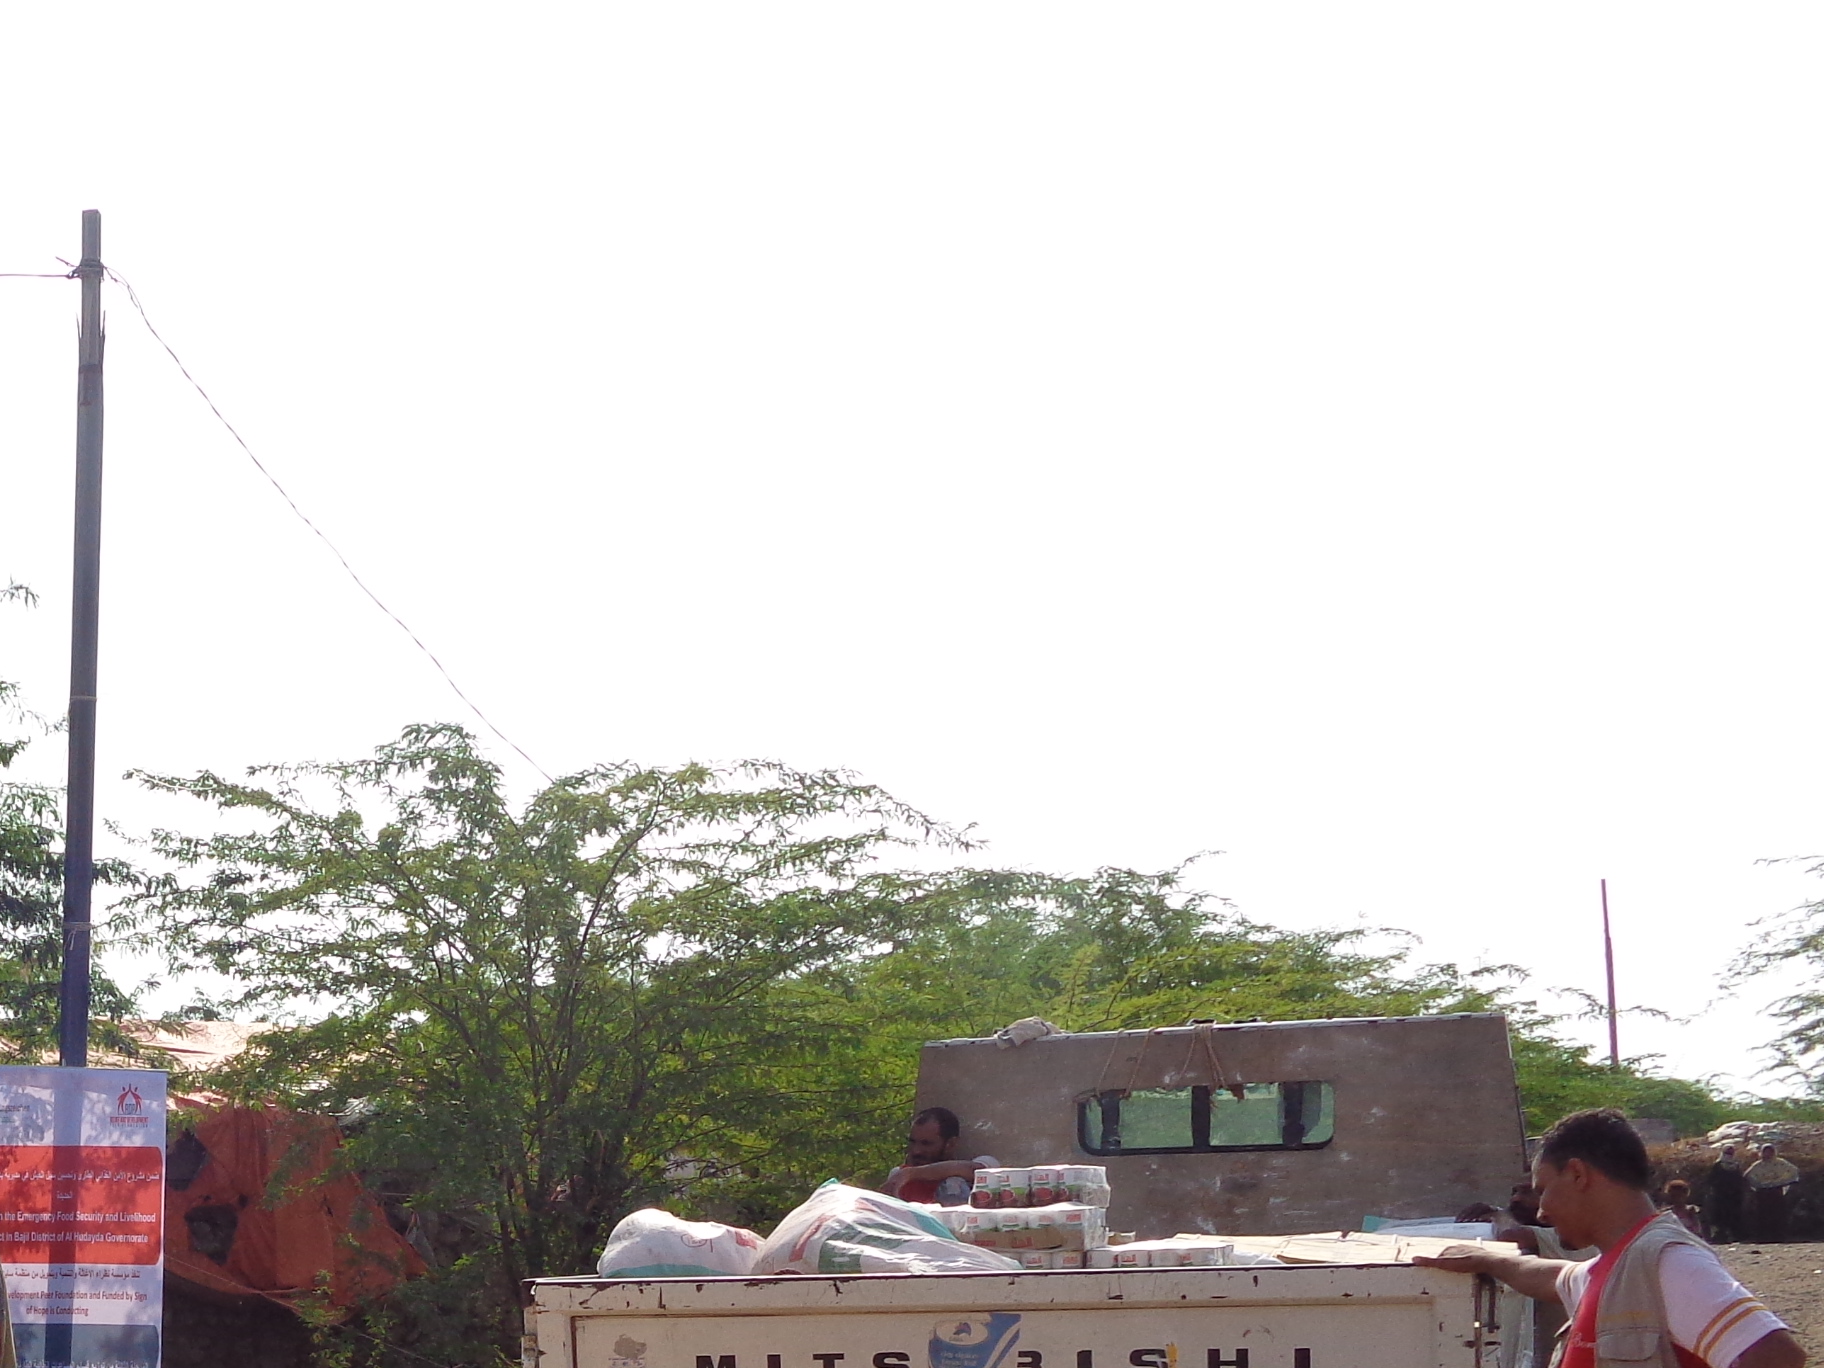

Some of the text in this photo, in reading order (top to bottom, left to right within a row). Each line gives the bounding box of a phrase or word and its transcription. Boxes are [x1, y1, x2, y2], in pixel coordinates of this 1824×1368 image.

[4, 1211, 16, 1221] the
[17, 1211, 55, 1223] Emergency
[57, 1211, 74, 1221] Food
[75, 1211, 103, 1224] Security
[105, 1212, 118, 1222] and
[119, 1212, 156, 1223] Livelihood
[31, 1232, 56, 1242] District
[57, 1232, 64, 1242] of
[65, 1232, 74, 1242] Al
[74, 1232, 104, 1245] Hudayda
[104, 1232, 149, 1244] Governorate
[7, 1291, 40, 1301] velopment
[55, 1290, 88, 1300] Foundation
[88, 1290, 101, 1300] and
[101, 1290, 125, 1301] Funded
[125, 1291, 133, 1302] by
[134, 1292, 148, 1303] Sign
[26, 1306, 33, 1315] of
[33, 1306, 50, 1317] Hope
[56, 1306, 89, 1317] Conducting
